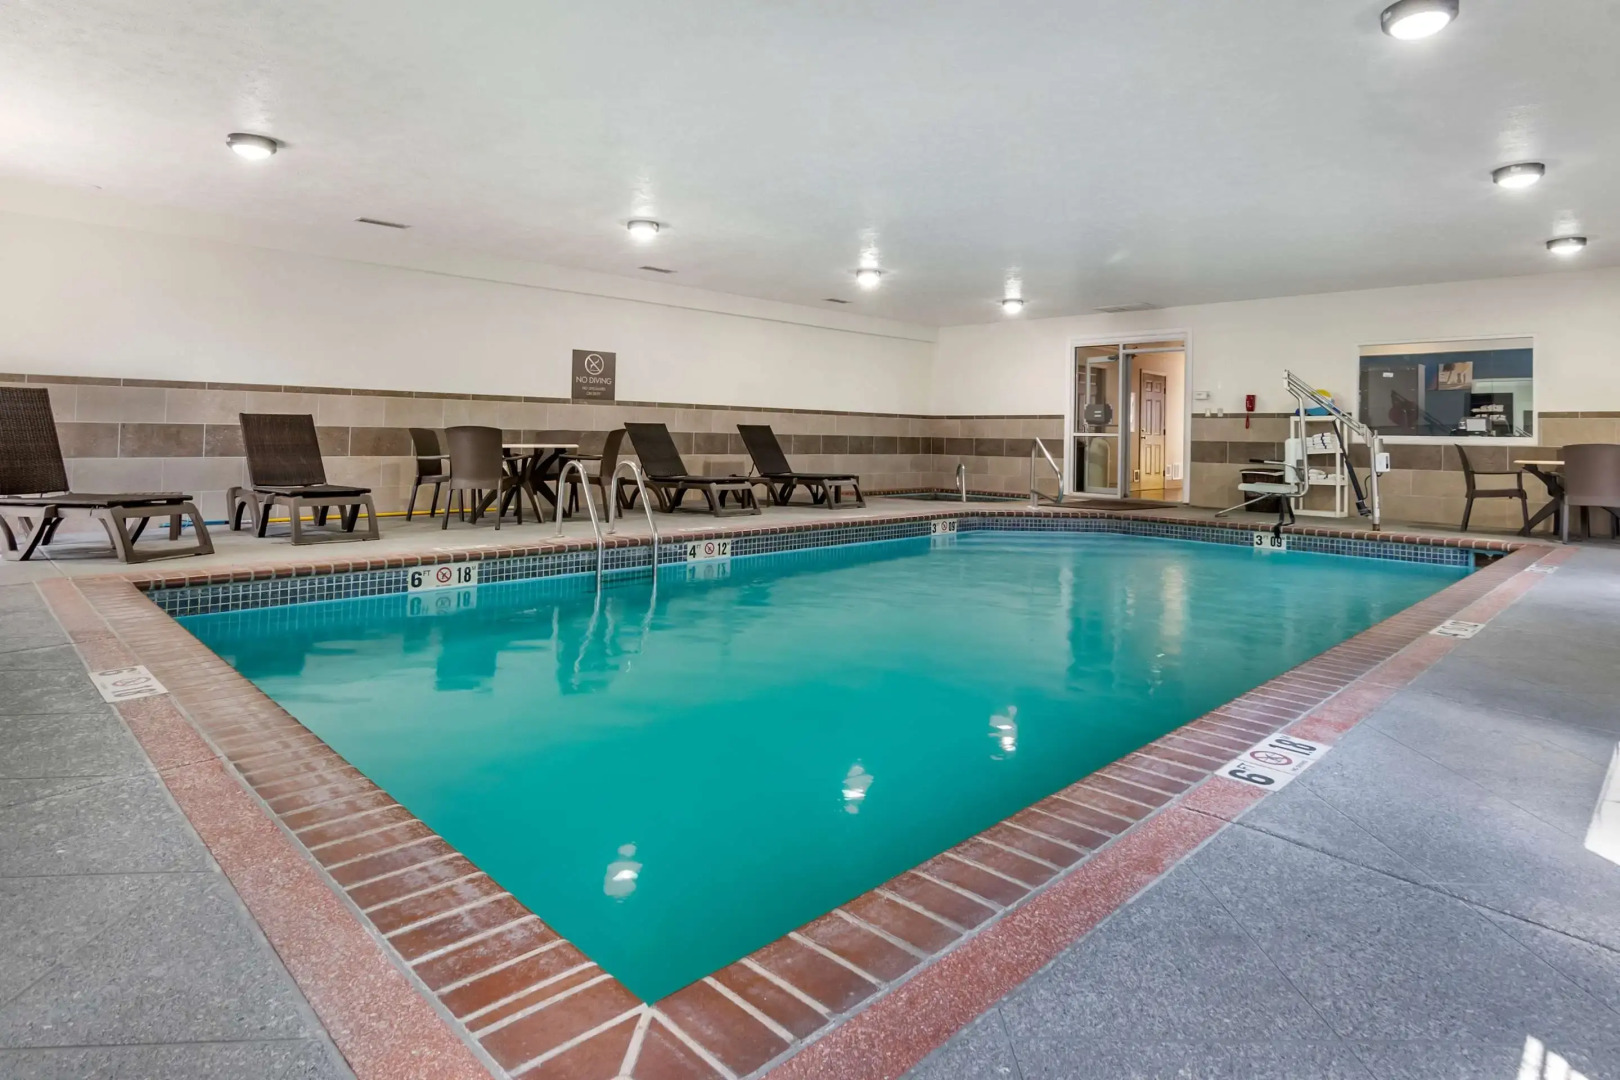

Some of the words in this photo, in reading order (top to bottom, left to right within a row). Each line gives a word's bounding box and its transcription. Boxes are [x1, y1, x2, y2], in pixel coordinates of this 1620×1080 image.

[575, 376, 588, 384] NO
[589, 376, 613, 385] DIVING
[932, 523, 937, 533] 3
[1255, 535, 1263, 546] 3
[689, 545, 696, 558] 4
